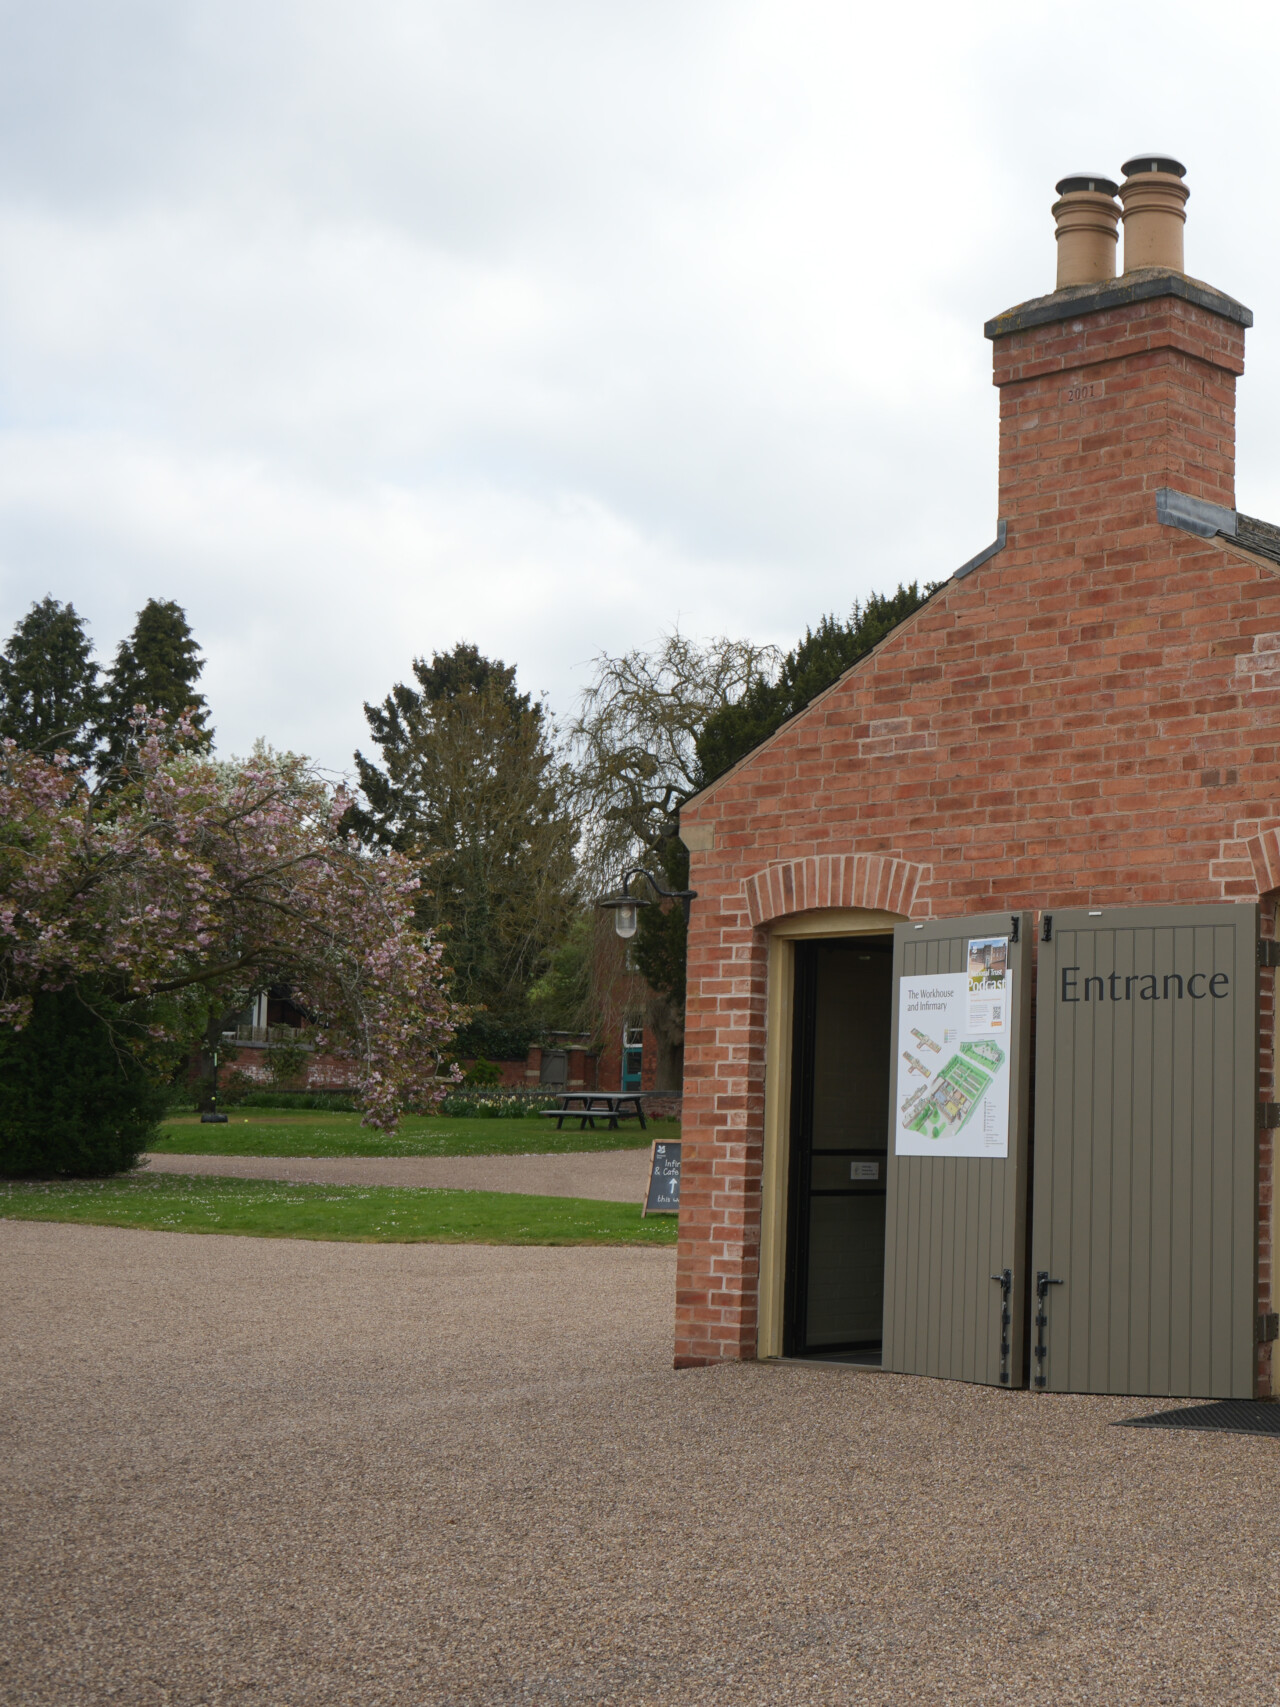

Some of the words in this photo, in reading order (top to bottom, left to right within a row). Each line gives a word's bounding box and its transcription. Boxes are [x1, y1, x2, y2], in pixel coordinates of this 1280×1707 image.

[990, 968, 1003, 976] Trust
[968, 977, 1006, 992] Podcast
[1061, 967, 1230, 1003] Entrance
[908, 989, 919, 1000] The
[920, 988, 954, 999] Workhouse
[907, 1001, 919, 1012] and
[920, 1001, 947, 1012] Infirmary
[654, 1166, 661, 1176] &
[658, 1194, 671, 1203] this
